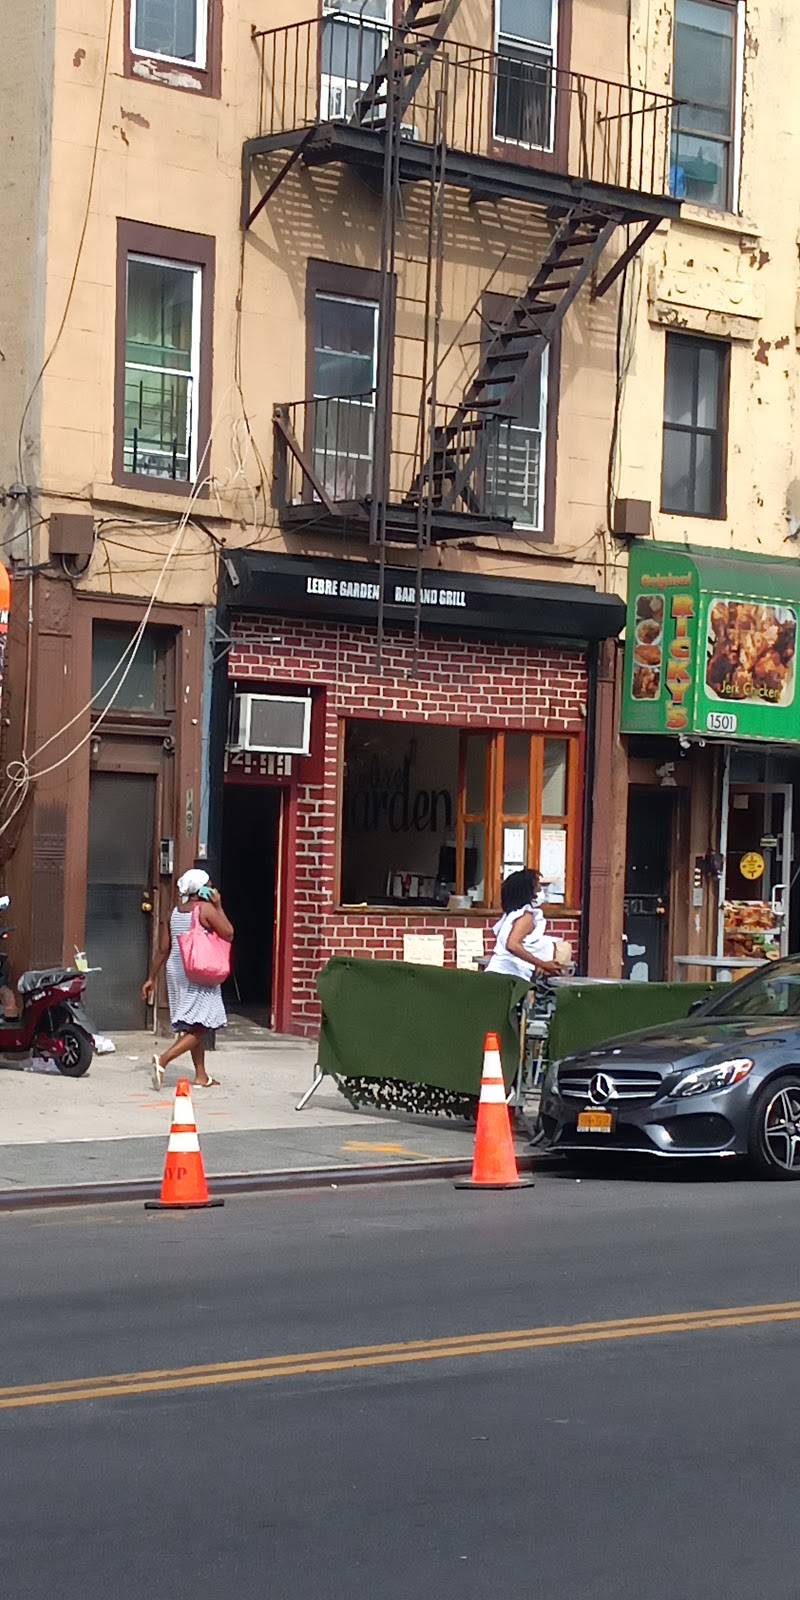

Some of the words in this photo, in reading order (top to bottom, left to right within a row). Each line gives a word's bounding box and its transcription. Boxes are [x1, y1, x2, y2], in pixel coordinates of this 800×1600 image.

[307, 577, 338, 595] LEBRE
[339, 581, 380, 600] GARDEN
[394, 586, 416, 603] BAR
[438, 589, 467, 607] GRILL
[720, 680, 740, 694] Jerk
[710, 714, 734, 730] 1501
